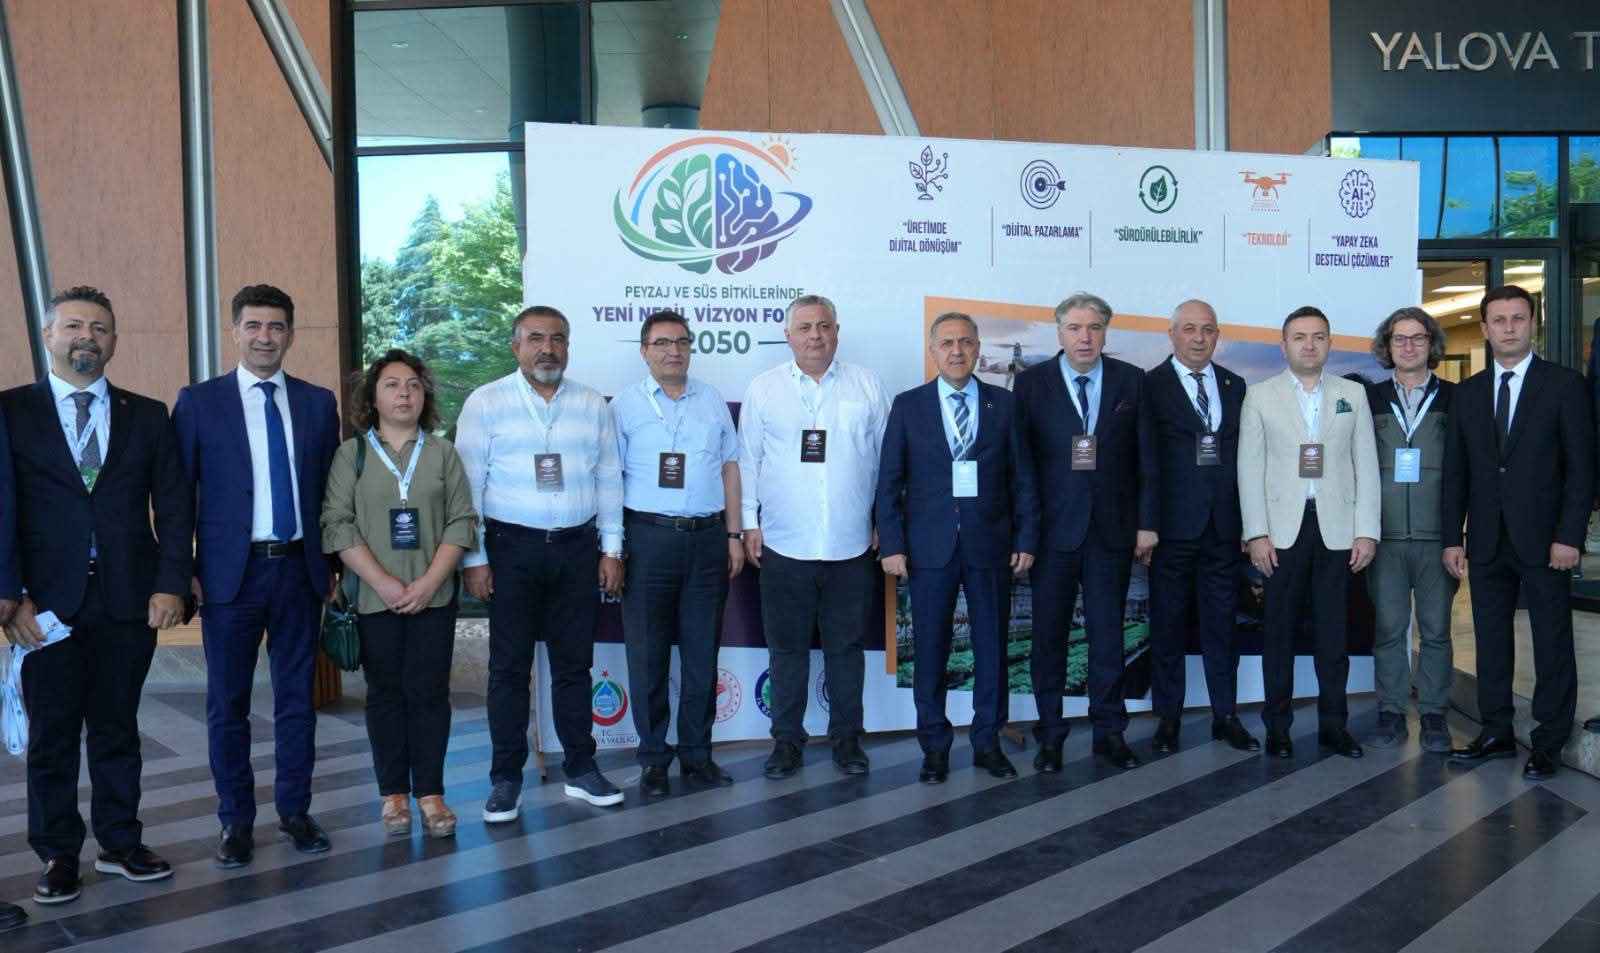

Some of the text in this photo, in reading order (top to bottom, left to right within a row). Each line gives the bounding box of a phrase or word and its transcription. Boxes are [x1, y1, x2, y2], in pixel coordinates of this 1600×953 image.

[1370, 31, 1600, 71] YALOVA T
[1351, 187, 1364, 200] AI
[889, 237, 918, 252] DİJİTAL
[1359, 235, 1379, 249] ZEKA
[1315, 252, 1350, 267] DESTEKLİ
[625, 283, 805, 300] PEYZAJ VE SÜS BİTKİLERİNDE
[592, 302, 633, 322] YENİ
[694, 303, 757, 323] VİZYON
